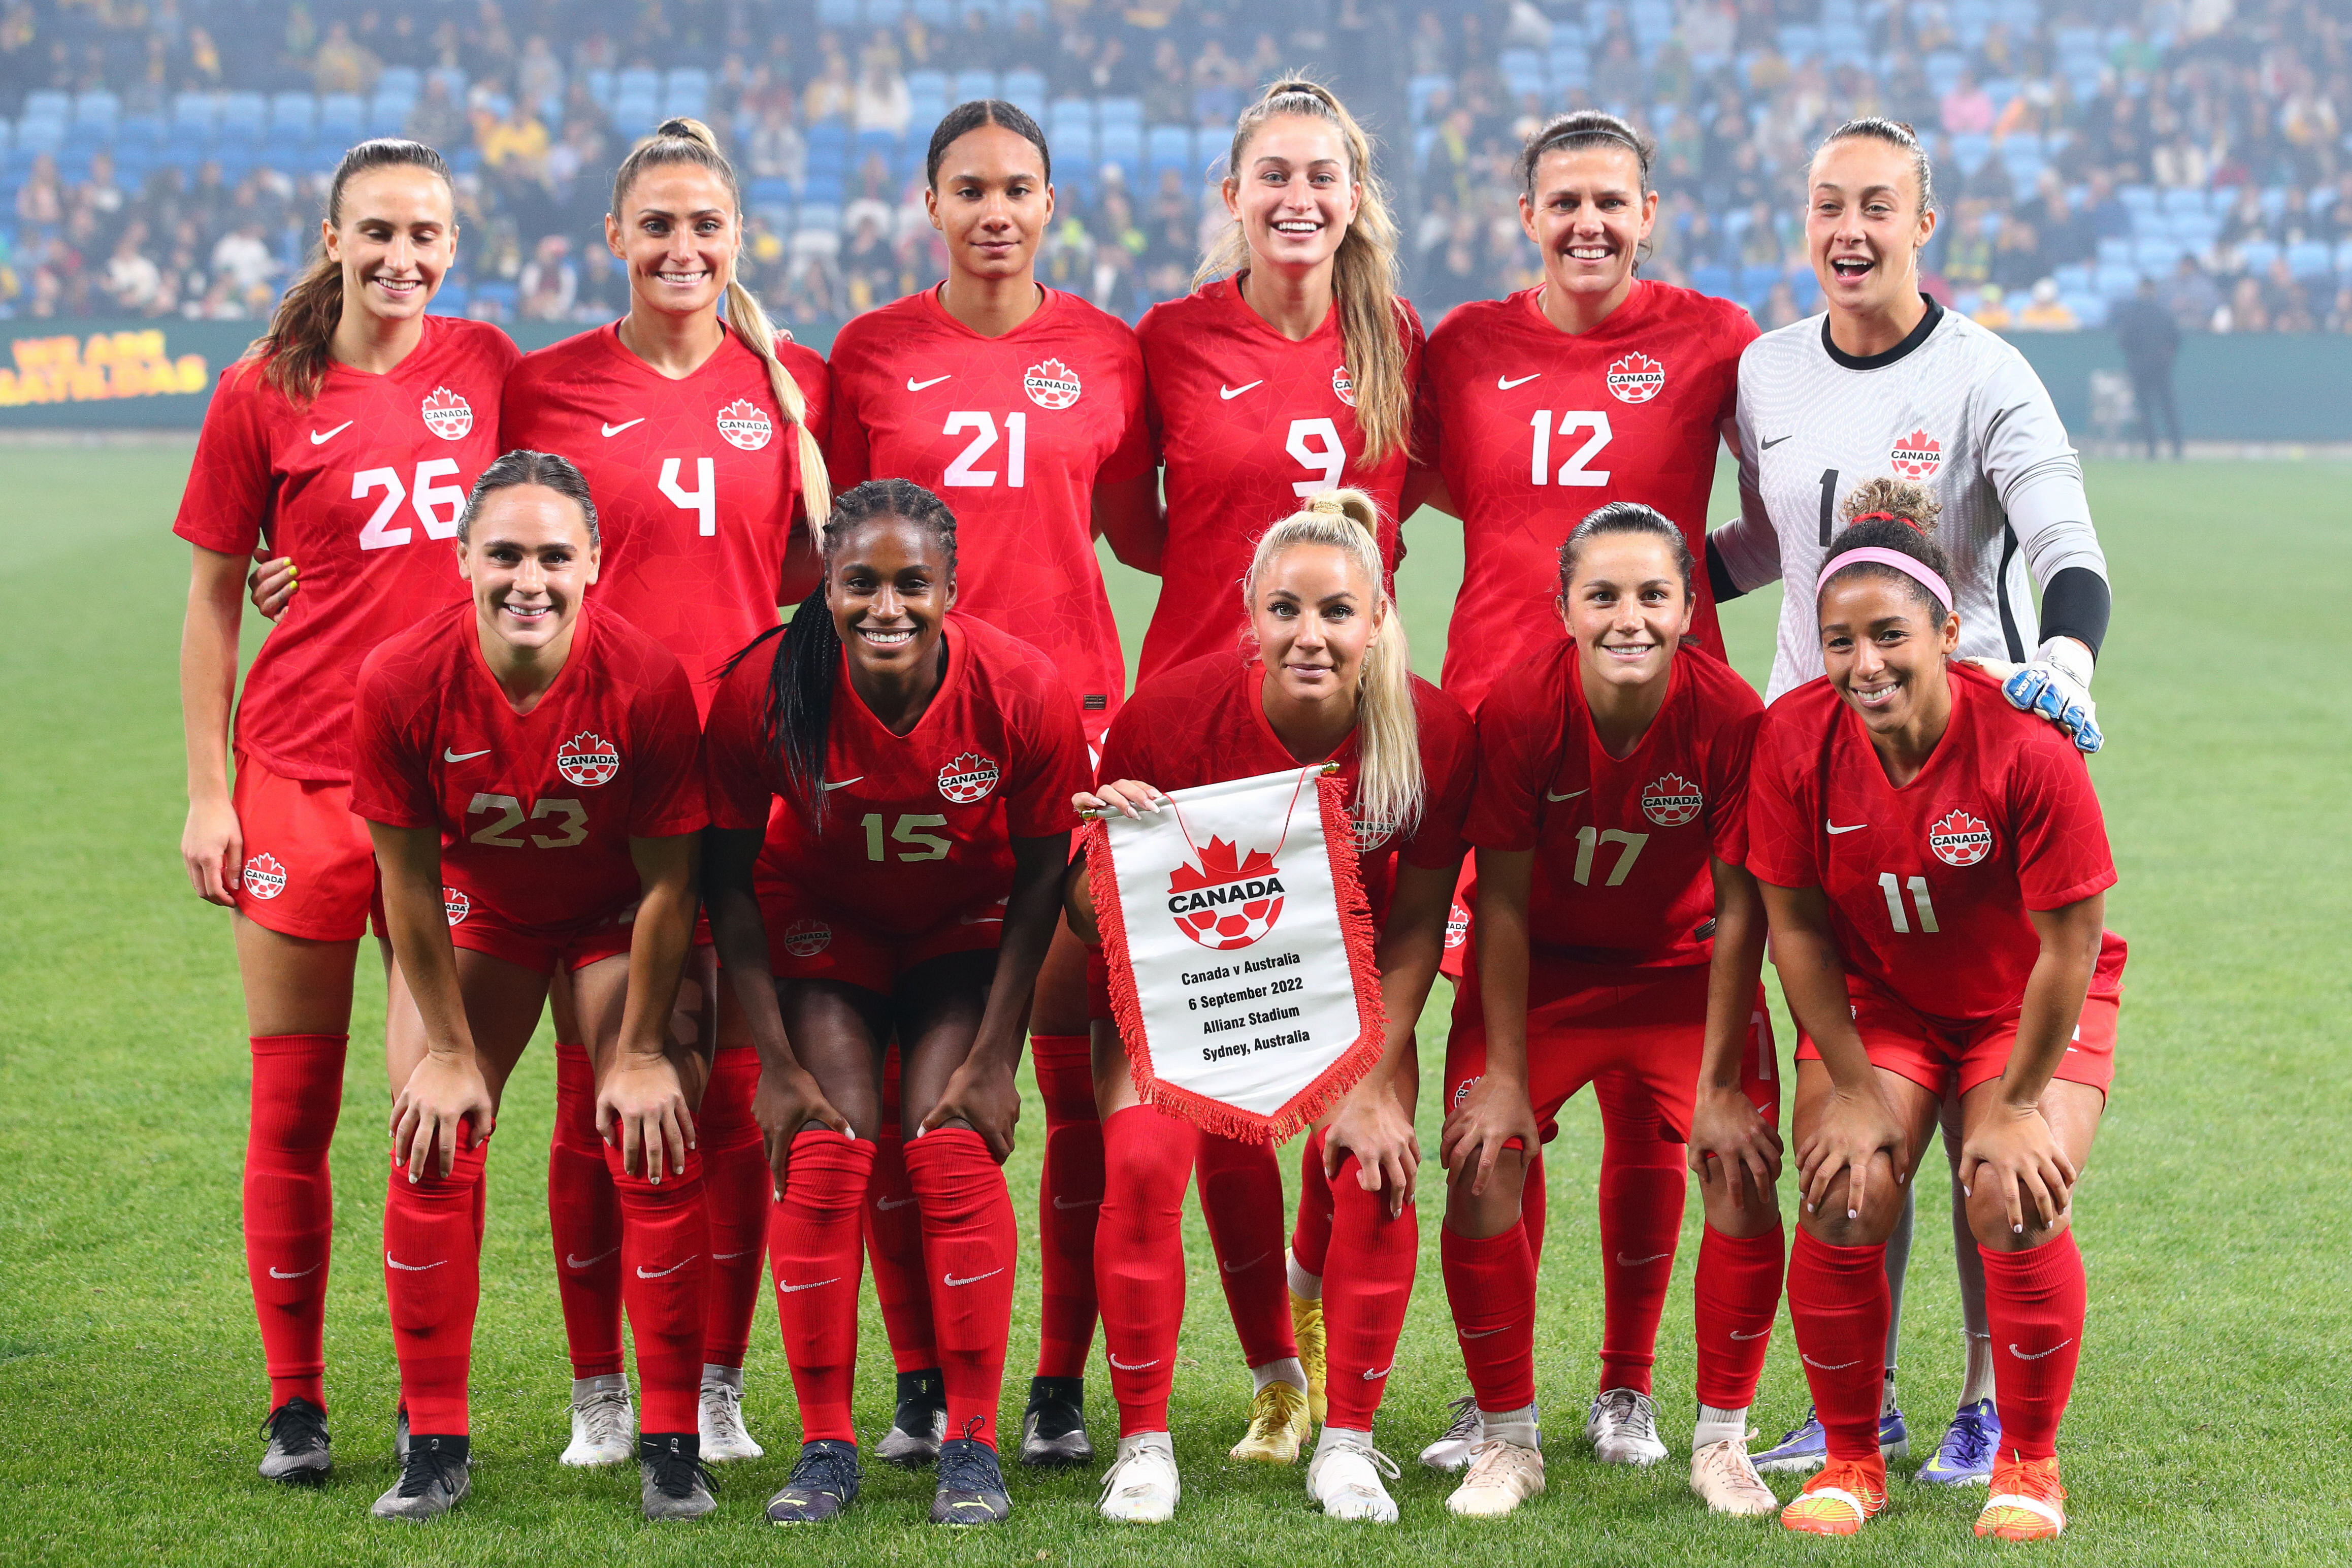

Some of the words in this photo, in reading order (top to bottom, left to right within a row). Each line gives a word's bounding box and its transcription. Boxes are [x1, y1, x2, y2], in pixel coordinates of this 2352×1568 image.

[1026, 378, 1078, 392] CANADA
[1609, 374, 1662, 383] CANADA
[424, 409, 470, 420] CANADA
[719, 421, 770, 431] CANADA
[942, 411, 1026, 487] 21
[1285, 417, 1346, 497] 9
[1530, 410, 1613, 486] 12
[1891, 450, 1941, 461] CANADA
[351, 458, 467, 550] 26
[658, 458, 715, 536] 4
[1819, 469, 1839, 547] 1
[559, 755, 617, 767] CANADA
[939, 771, 996, 788] CANADA
[1643, 796, 1700, 807] CANADA
[467, 793, 589, 848] 23
[861, 813, 952, 862] 15
[1932, 834, 1989, 846] CANADA
[1574, 826, 1649, 887] 17
[245, 870, 283, 884] CANADA
[1168, 877, 1285, 913] CANADA
[1878, 872, 1939, 933] 11
[786, 932, 829, 944] CANADA
[1182, 966, 1230, 985] Canada
[1233, 965, 1240, 975] v
[1245, 952, 1301, 974] Australia
[1188, 998, 1197, 1010] 6
[1201, 986, 1267, 1008] September
[1271, 977, 1303, 995] 2022
[1203, 1016, 1246, 1034] Allianz
[1249, 1006, 1300, 1027] Stadium
[1202, 1042, 1251, 1062] Sydney,
[1254, 1029, 1310, 1051] Australia
